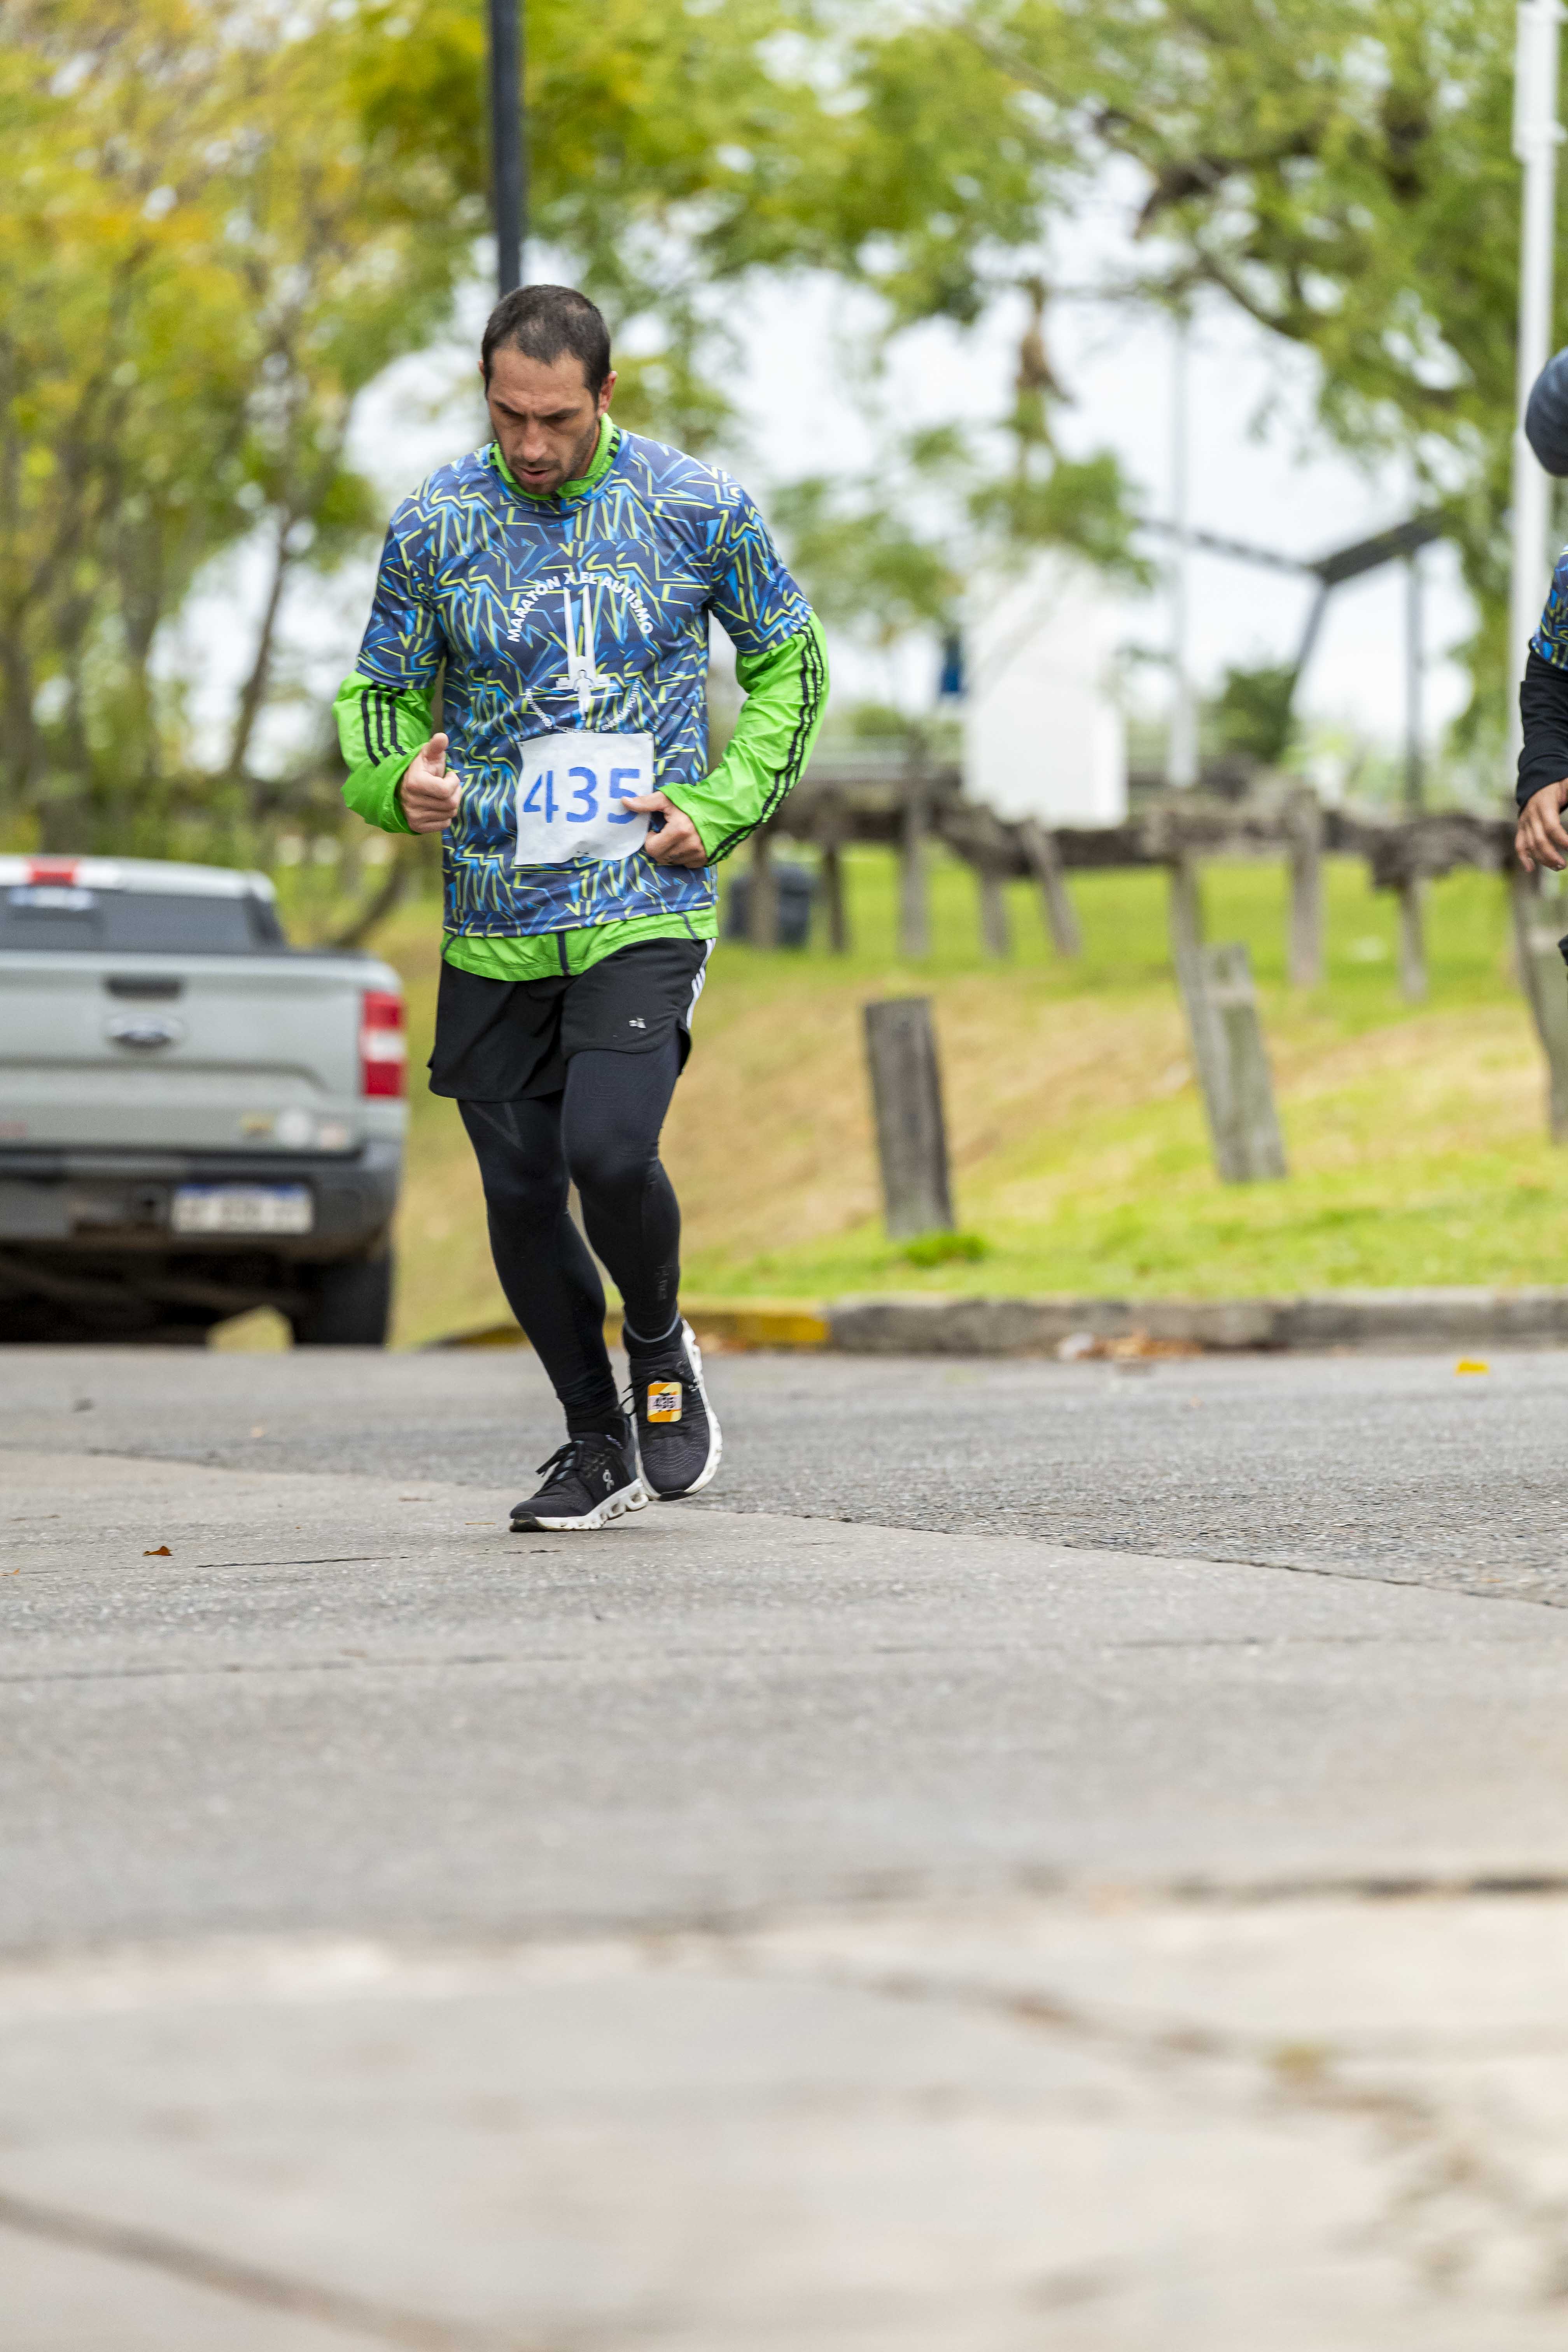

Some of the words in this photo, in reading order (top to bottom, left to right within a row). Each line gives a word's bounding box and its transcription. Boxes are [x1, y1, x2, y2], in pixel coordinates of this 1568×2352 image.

[563, 572, 575, 584] X
[579, 572, 597, 584] EL
[600, 576, 654, 634] AUTISMO
[523, 766, 640, 824] 435
